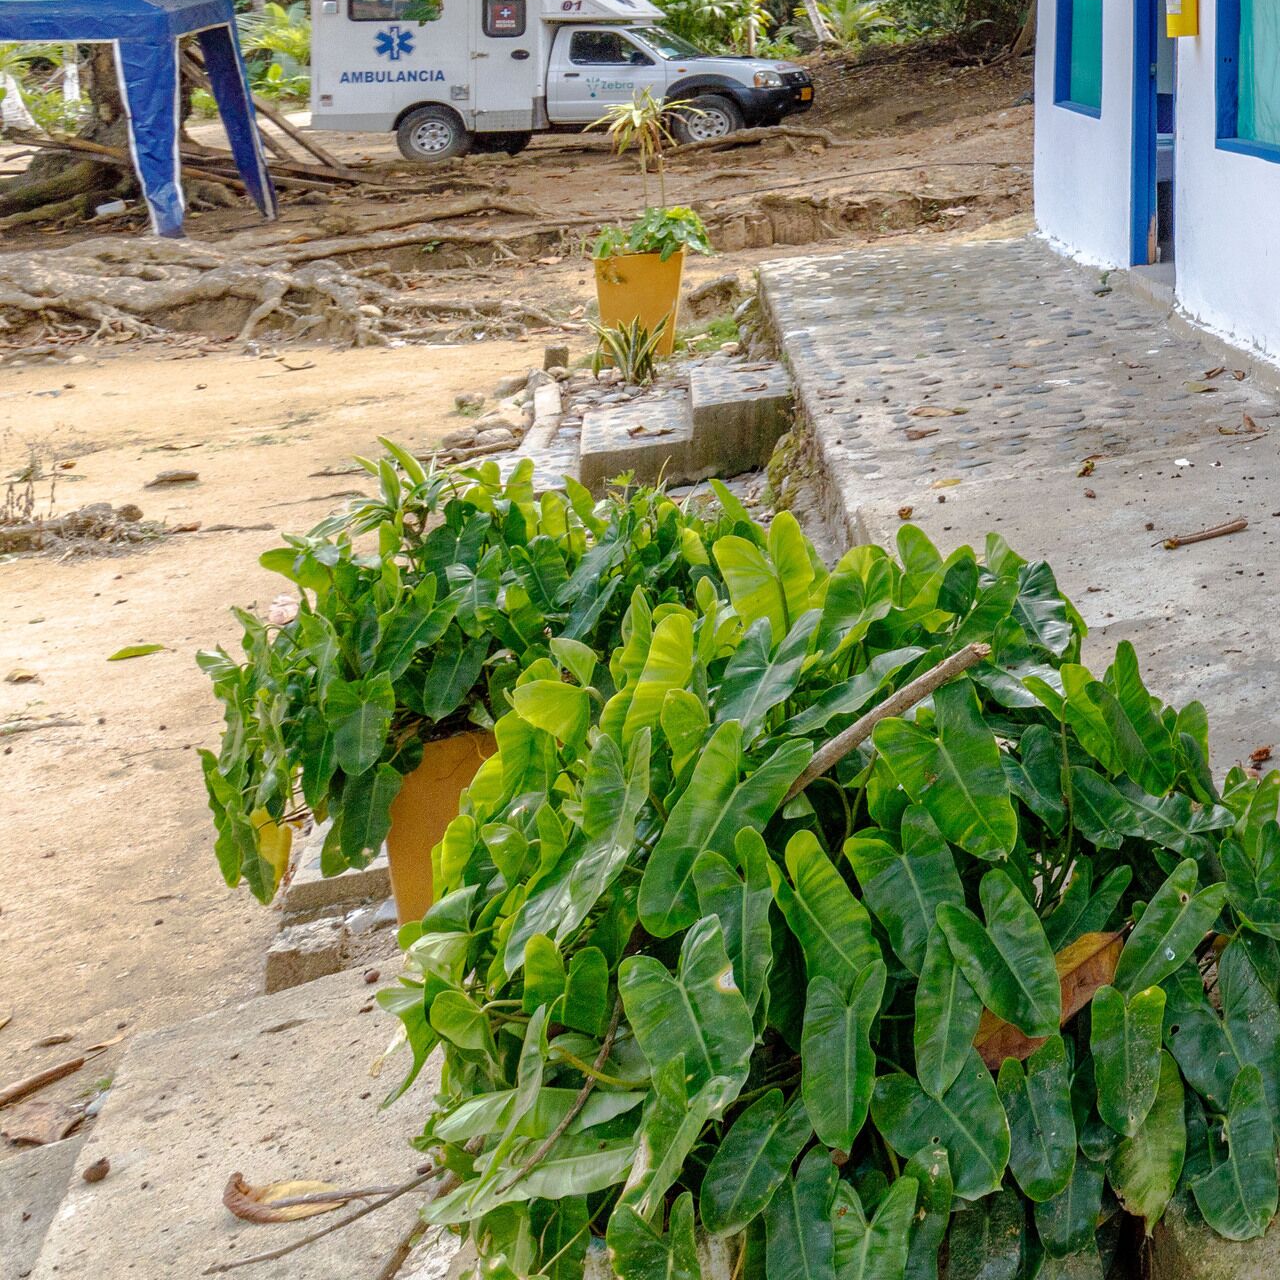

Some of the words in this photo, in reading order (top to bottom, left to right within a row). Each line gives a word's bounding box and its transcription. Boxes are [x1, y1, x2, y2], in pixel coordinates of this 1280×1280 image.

[562, 0, 583, 11] 01
[339, 70, 446, 84] AMBULANCIA
[601, 80, 635, 90] Zebra
